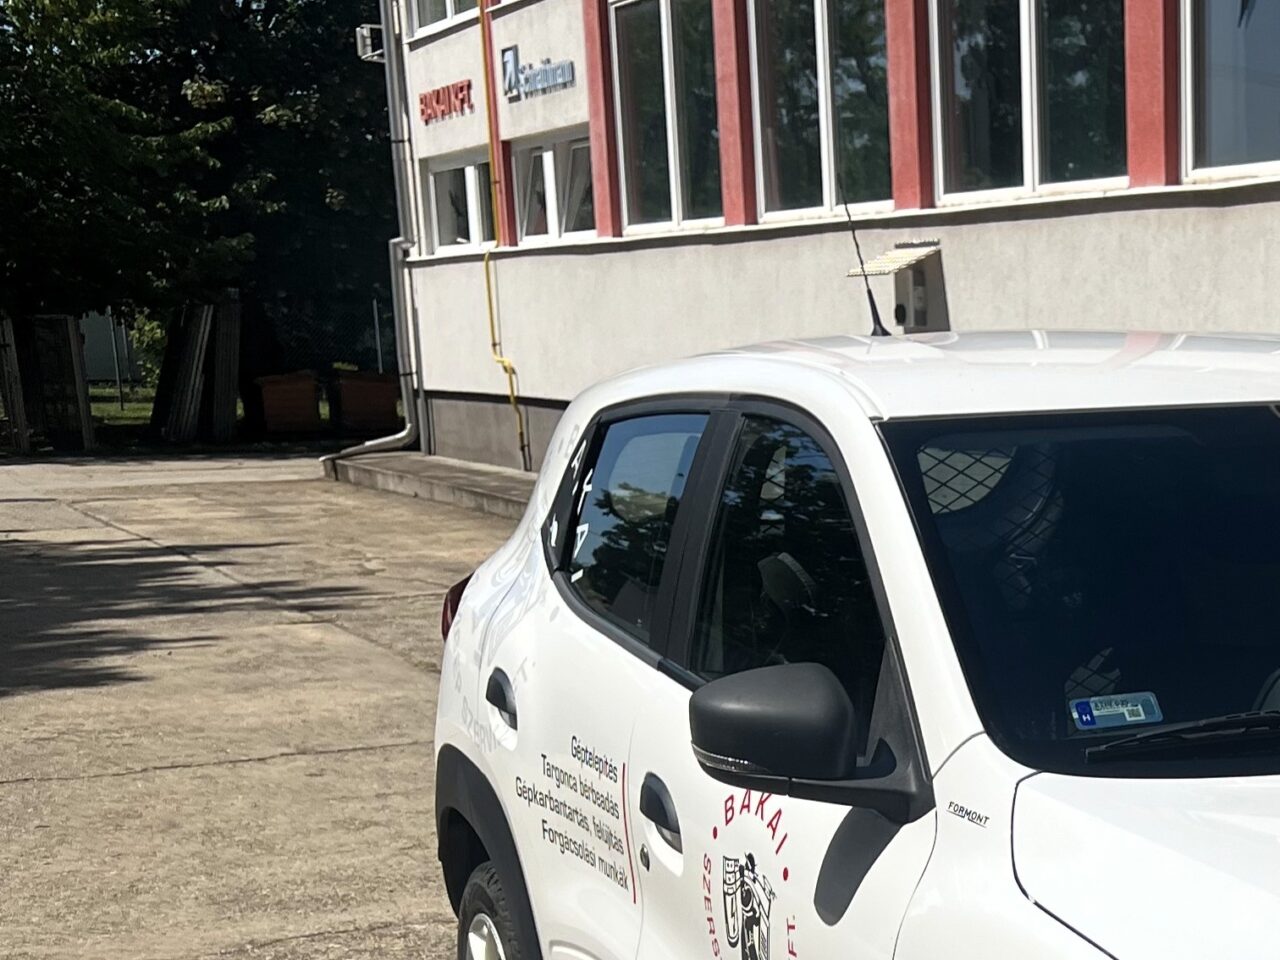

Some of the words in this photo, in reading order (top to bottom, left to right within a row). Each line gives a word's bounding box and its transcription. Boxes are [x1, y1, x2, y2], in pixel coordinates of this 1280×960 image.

[541, 753, 578, 793] Targonca
[579, 774, 620, 820] bérbeadás
[947, 801, 990, 826] FORMONT
[541, 819, 597, 868] Forgácsolási
[598, 856, 629, 891] munkák
[724, 789, 788, 855] BAKAI
